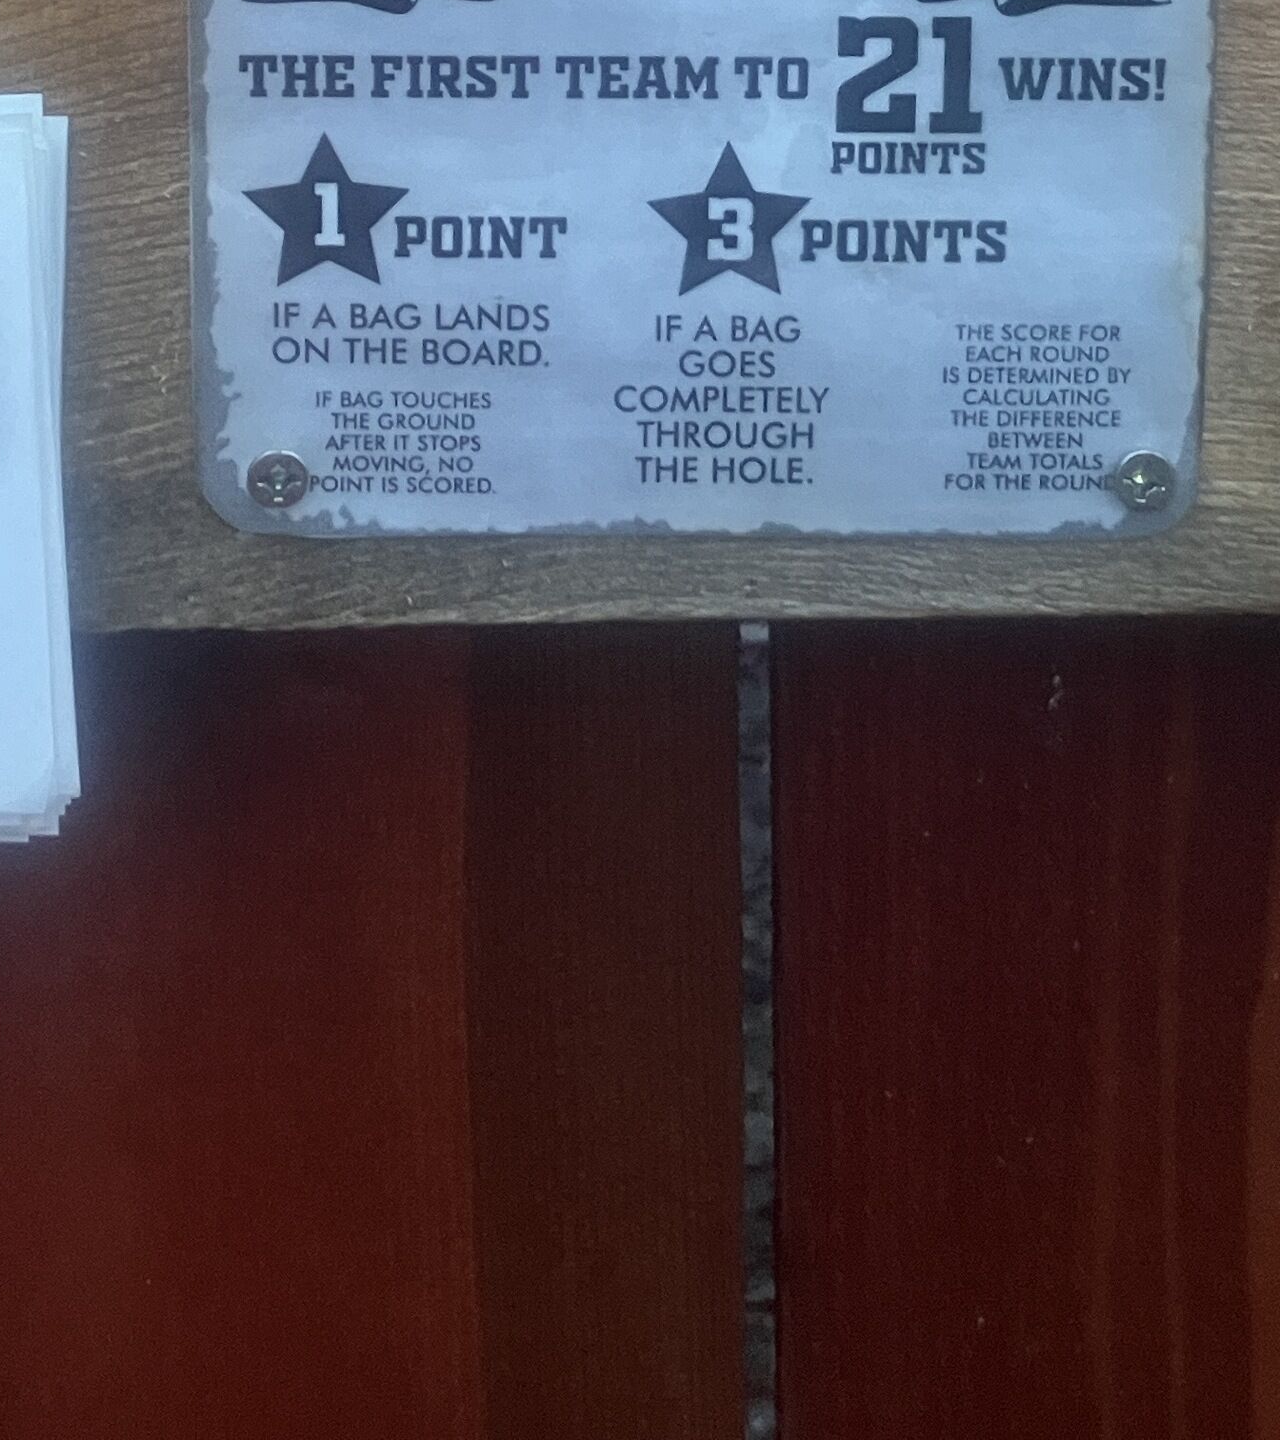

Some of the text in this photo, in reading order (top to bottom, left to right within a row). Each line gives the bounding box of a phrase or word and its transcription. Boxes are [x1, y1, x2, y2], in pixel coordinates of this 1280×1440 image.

[239, 16, 1166, 134] THE FIRST TEAM TO 21 WINS!
[831, 142, 985, 174] POINTS
[315, 182, 567, 258] 1 POINT
[706, 197, 1007, 263] 3 POINTS
[274, 303, 549, 332] IF A BAG LANDS
[656, 315, 800, 343] IF A BAG
[956, 324, 1120, 341] THE SCORE FOR
[272, 336, 549, 366] ON THE BOARD.
[966, 346, 1109, 363] EACH ROUND
[679, 350, 775, 378] GOES
[943, 366, 1131, 384] IS DETERMINED BY
[316, 391, 491, 409] IF BAG TOUCHES
[614, 385, 829, 413] COMPLETELY
[963, 389, 1110, 406] CALCULATING
[331, 412, 475, 430] THE GROUND
[951, 410, 1120, 428] THE DIFFERENCE
[325, 434, 481, 452] AFTER IT STOPS
[637, 421, 813, 449] THROUGH
[988, 432, 1083, 448] BETWEEN
[333, 456, 473, 478] MOVING, NO
[635, 457, 812, 484] THE HOLE.
[967, 452, 1102, 470] TEAM TOTALS
[310, 476, 496, 494] POINT IS SCORED.
[945, 474, 985, 491] FOR
[993, 474, 1031, 490] THE
